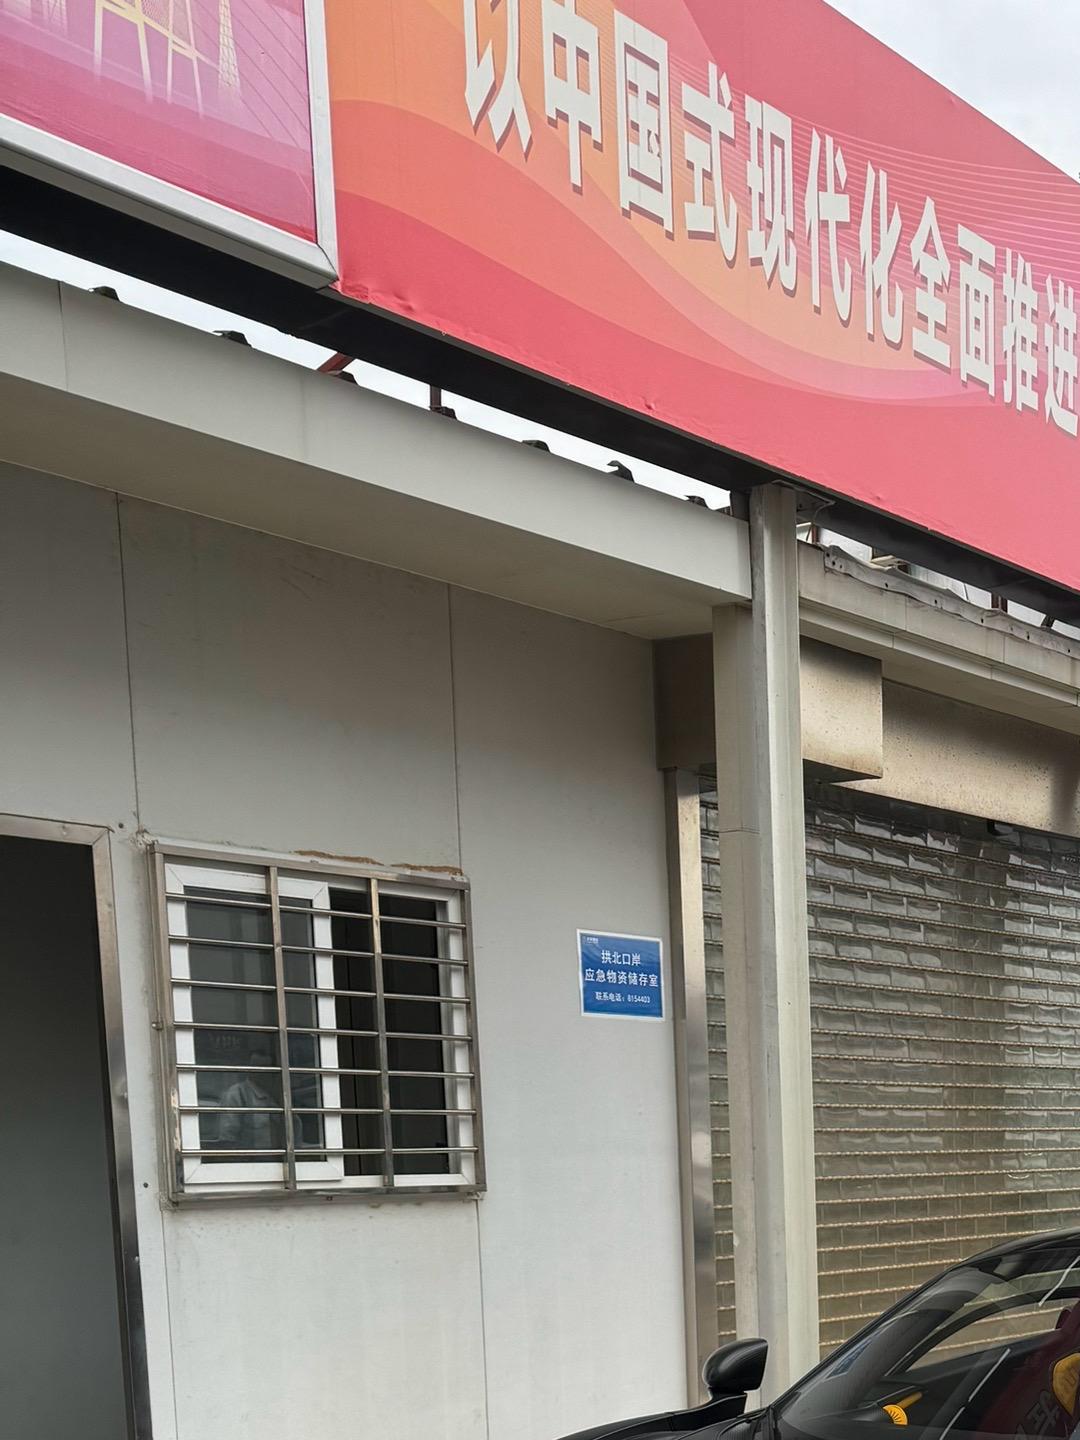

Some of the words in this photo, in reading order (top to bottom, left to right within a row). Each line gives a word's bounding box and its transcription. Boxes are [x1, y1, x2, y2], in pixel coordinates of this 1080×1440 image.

[601, 949, 641, 966] 拱北口岸
[585, 968, 658, 987] 应急物资储存室
